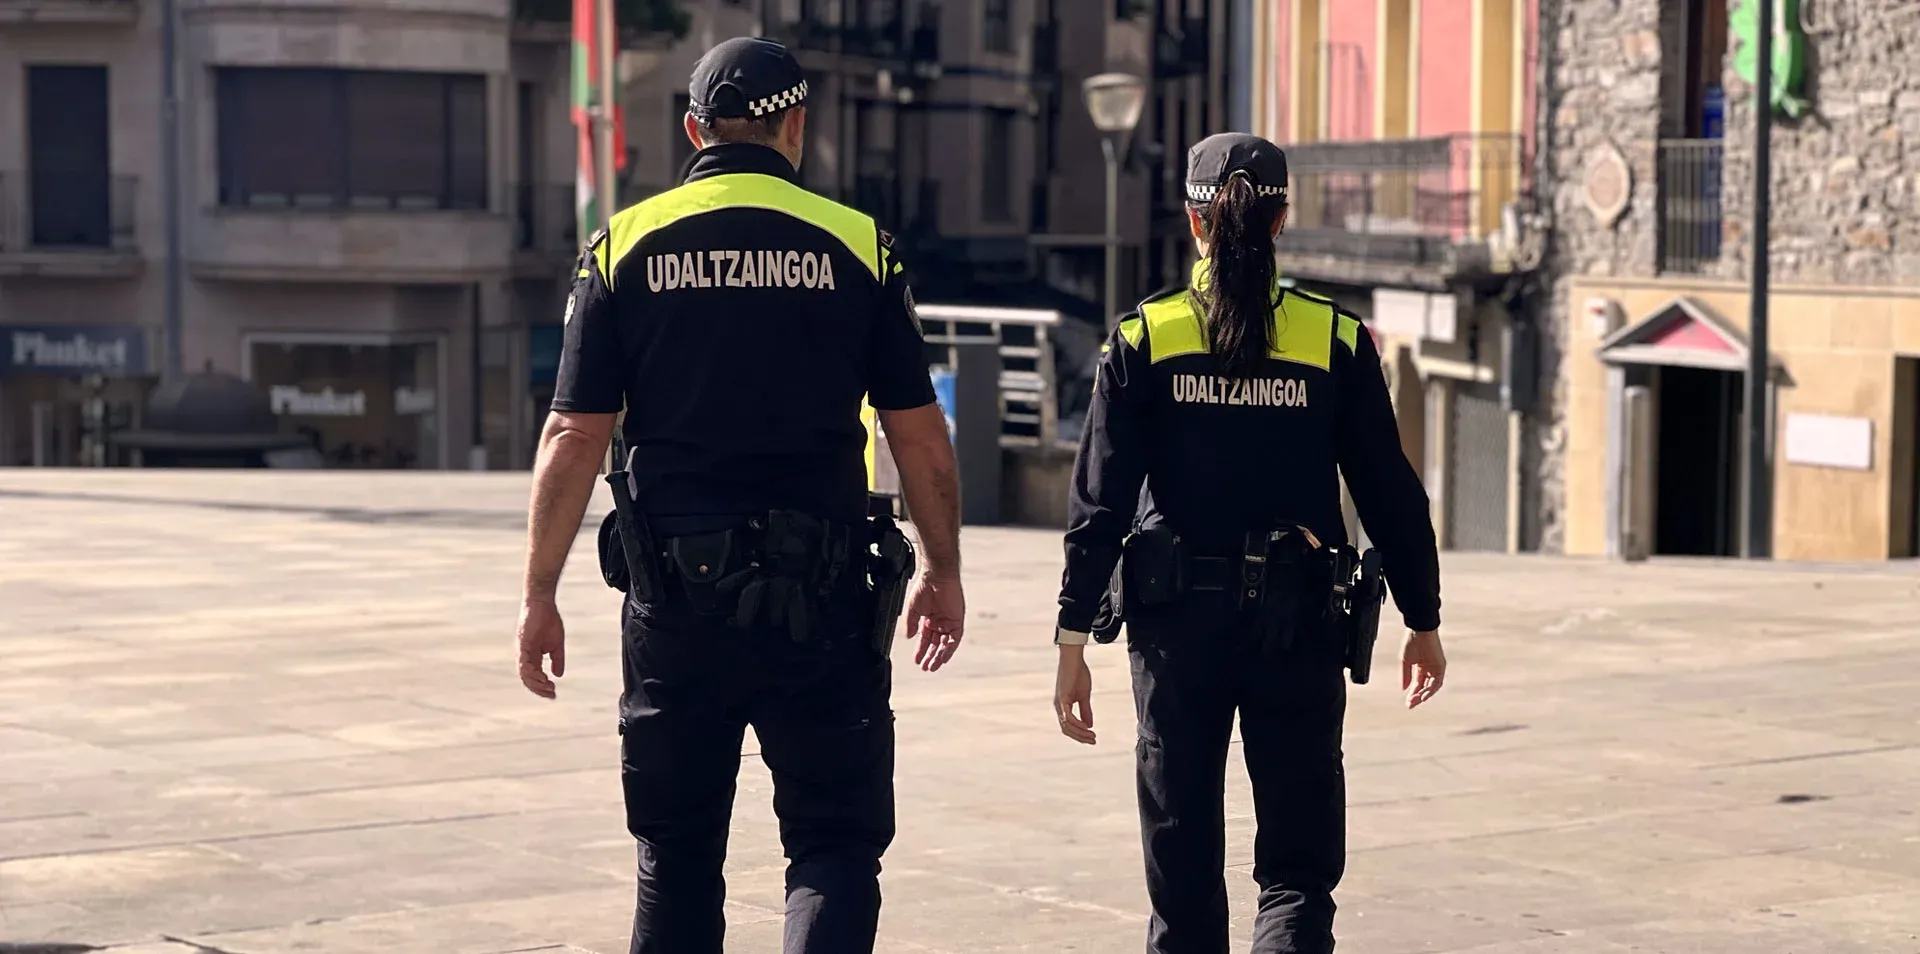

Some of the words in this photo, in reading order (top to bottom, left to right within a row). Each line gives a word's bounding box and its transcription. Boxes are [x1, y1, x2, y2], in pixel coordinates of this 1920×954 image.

[647, 250, 835, 293] UDALTZAINGOA
[12, 332, 126, 367] Phuket
[1173, 374, 1307, 407] UDALTZAINGOA
